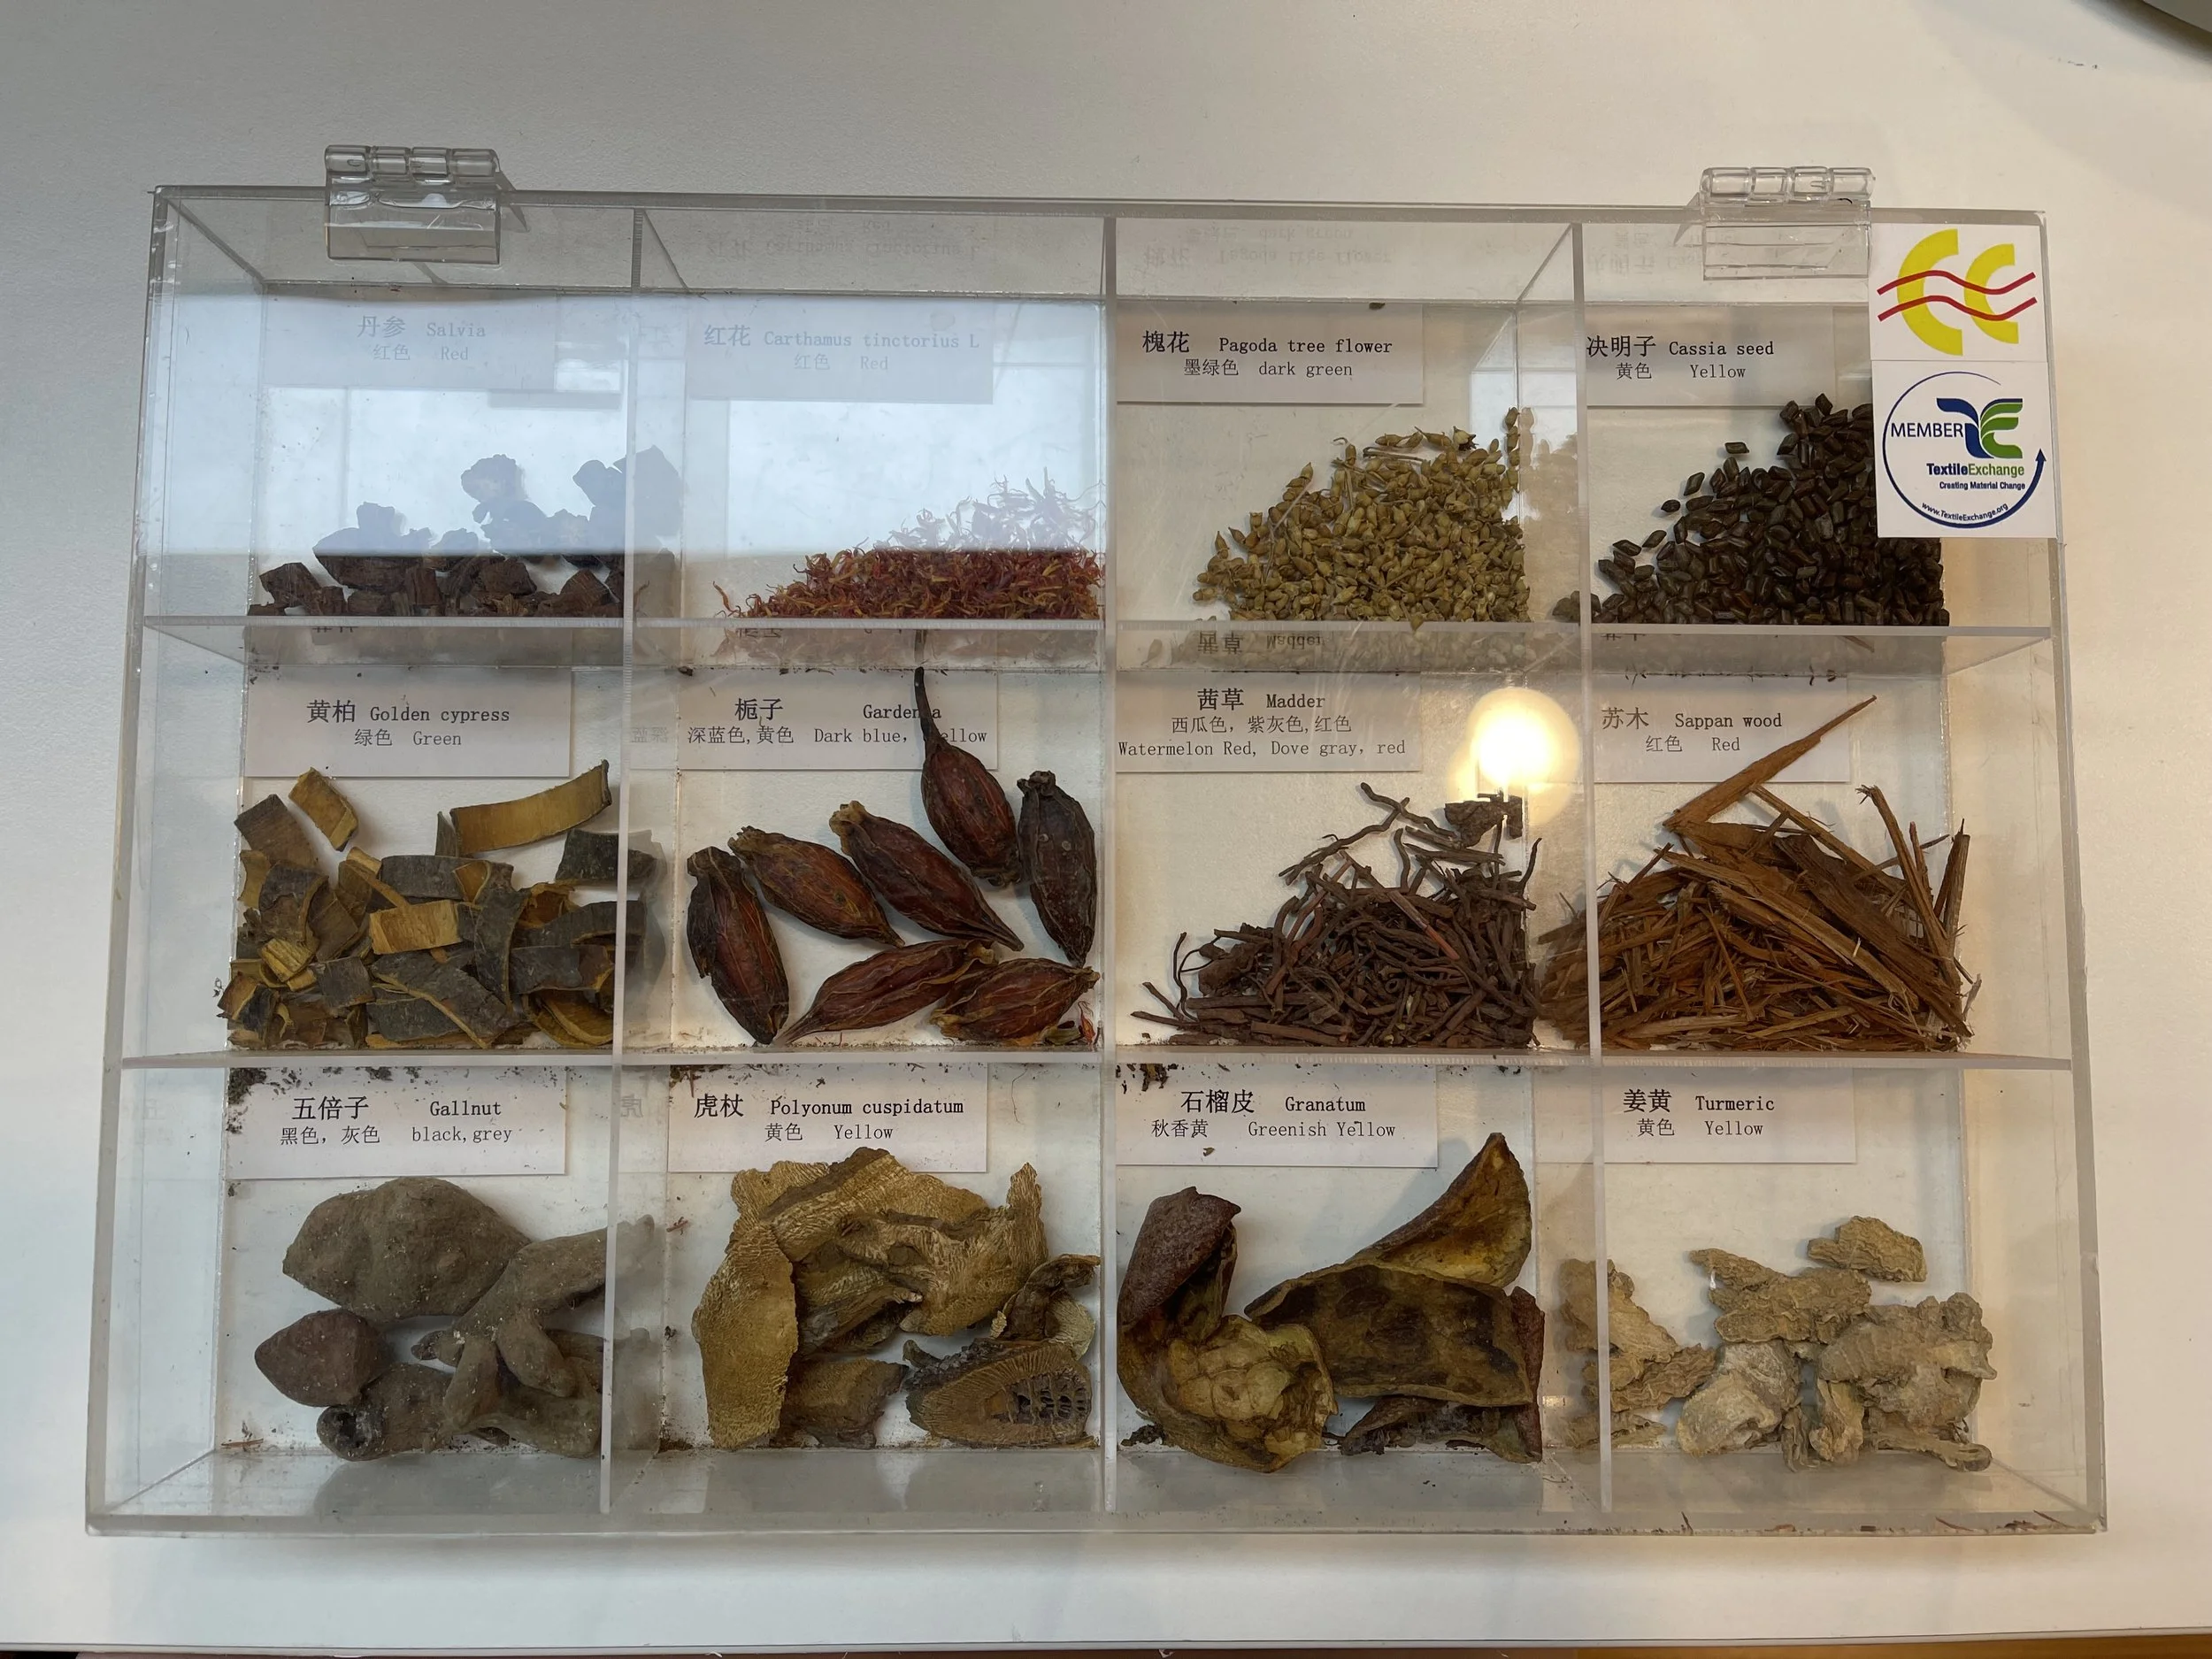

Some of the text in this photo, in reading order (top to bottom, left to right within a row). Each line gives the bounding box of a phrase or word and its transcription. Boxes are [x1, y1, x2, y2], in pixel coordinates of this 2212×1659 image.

[357, 316, 486, 337] 丹参 Salvia
[704, 325, 979, 348] 红花 Carthamus tinctorius L
[1142, 331, 1393, 355] 槐花 Pagoda tree flower
[1586, 335, 1774, 357] 决明子 Cassia seed
[373, 345, 468, 361] 红色 Red
[795, 354, 888, 371] 红色 Red
[1184, 359, 1353, 379] 墨绿色 dark green
[1616, 362, 1746, 380] 黄色 Yellow
[1892, 423, 1963, 437] MEMBER
[1927, 464, 2024, 477] TextileExchange
[2000, 482, 2025, 491] Change
[1922, 502, 2008, 521] www.TextileExchange.org
[1197, 689, 1325, 710] 茜草 Madder
[307, 700, 510, 724] 黄柏 Golden cypress
[734, 699, 941, 720] 栀子 Gardena
[1601, 707, 1782, 731] 苏木 Sappan wood
[354, 729, 462, 747] 绿色 Green
[814, 728, 852, 742] Dark
[935, 729, 987, 743] ellow
[1646, 735, 1740, 753] 红色 Red
[1118, 741, 1213, 756] Watermelon
[1224, 741, 1256, 757] Red,
[1271, 741, 1309, 756] Dove
[1377, 741, 1405, 754] red
[292, 1096, 501, 1120] 五倍子 Gallnut
[695, 1094, 964, 1118] 虎杖 Polyonum cuspidatum
[1181, 1089, 1366, 1114] 石榴皮 Granatum
[1624, 1089, 1775, 1113] 姜黄 Turmeric
[764, 1124, 894, 1141] 黄色 Yellow
[1152, 1120, 1395, 1138] 秋香黄 Greenish Yellow
[1637, 1118, 1763, 1136] 黄色 Yellow
